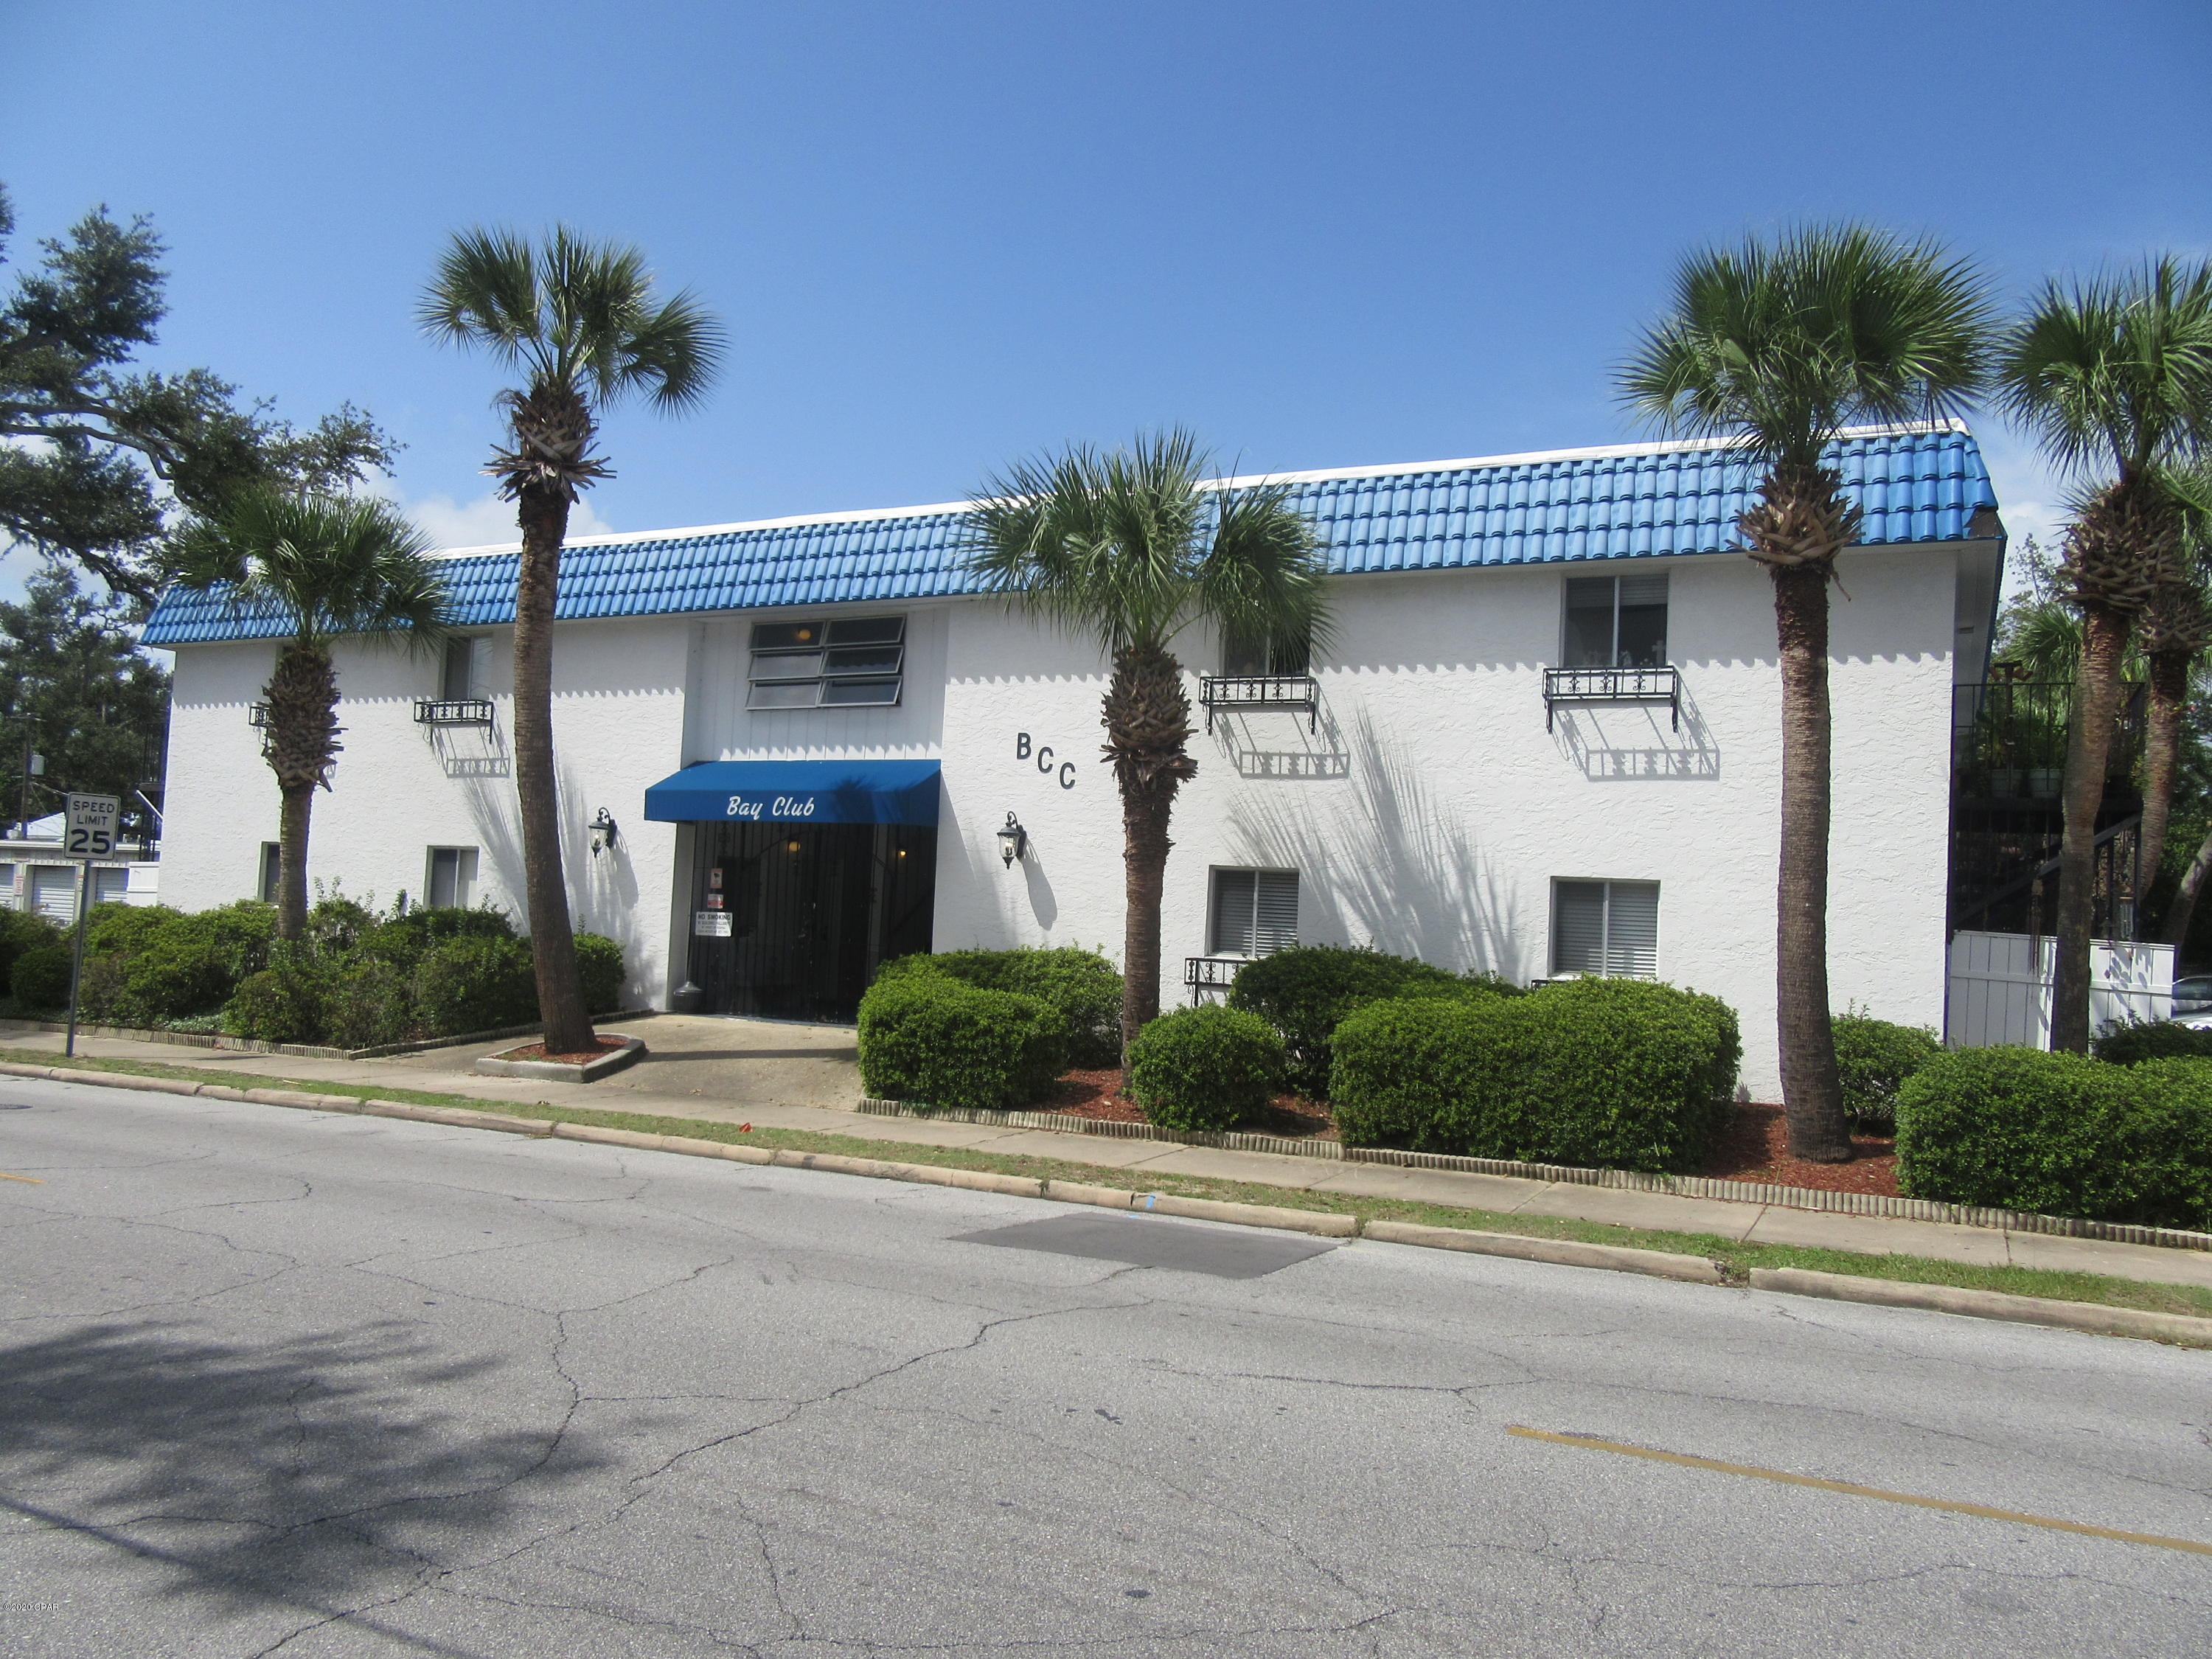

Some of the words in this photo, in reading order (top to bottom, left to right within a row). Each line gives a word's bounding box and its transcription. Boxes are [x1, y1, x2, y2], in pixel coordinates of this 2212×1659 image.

[1017, 732, 1076, 790] BCC
[72, 801, 115, 813] SPEED
[726, 796, 763, 821] Bay
[772, 796, 815, 816] Club
[77, 815, 108, 826] LIMIT
[69, 829, 111, 855] 25
